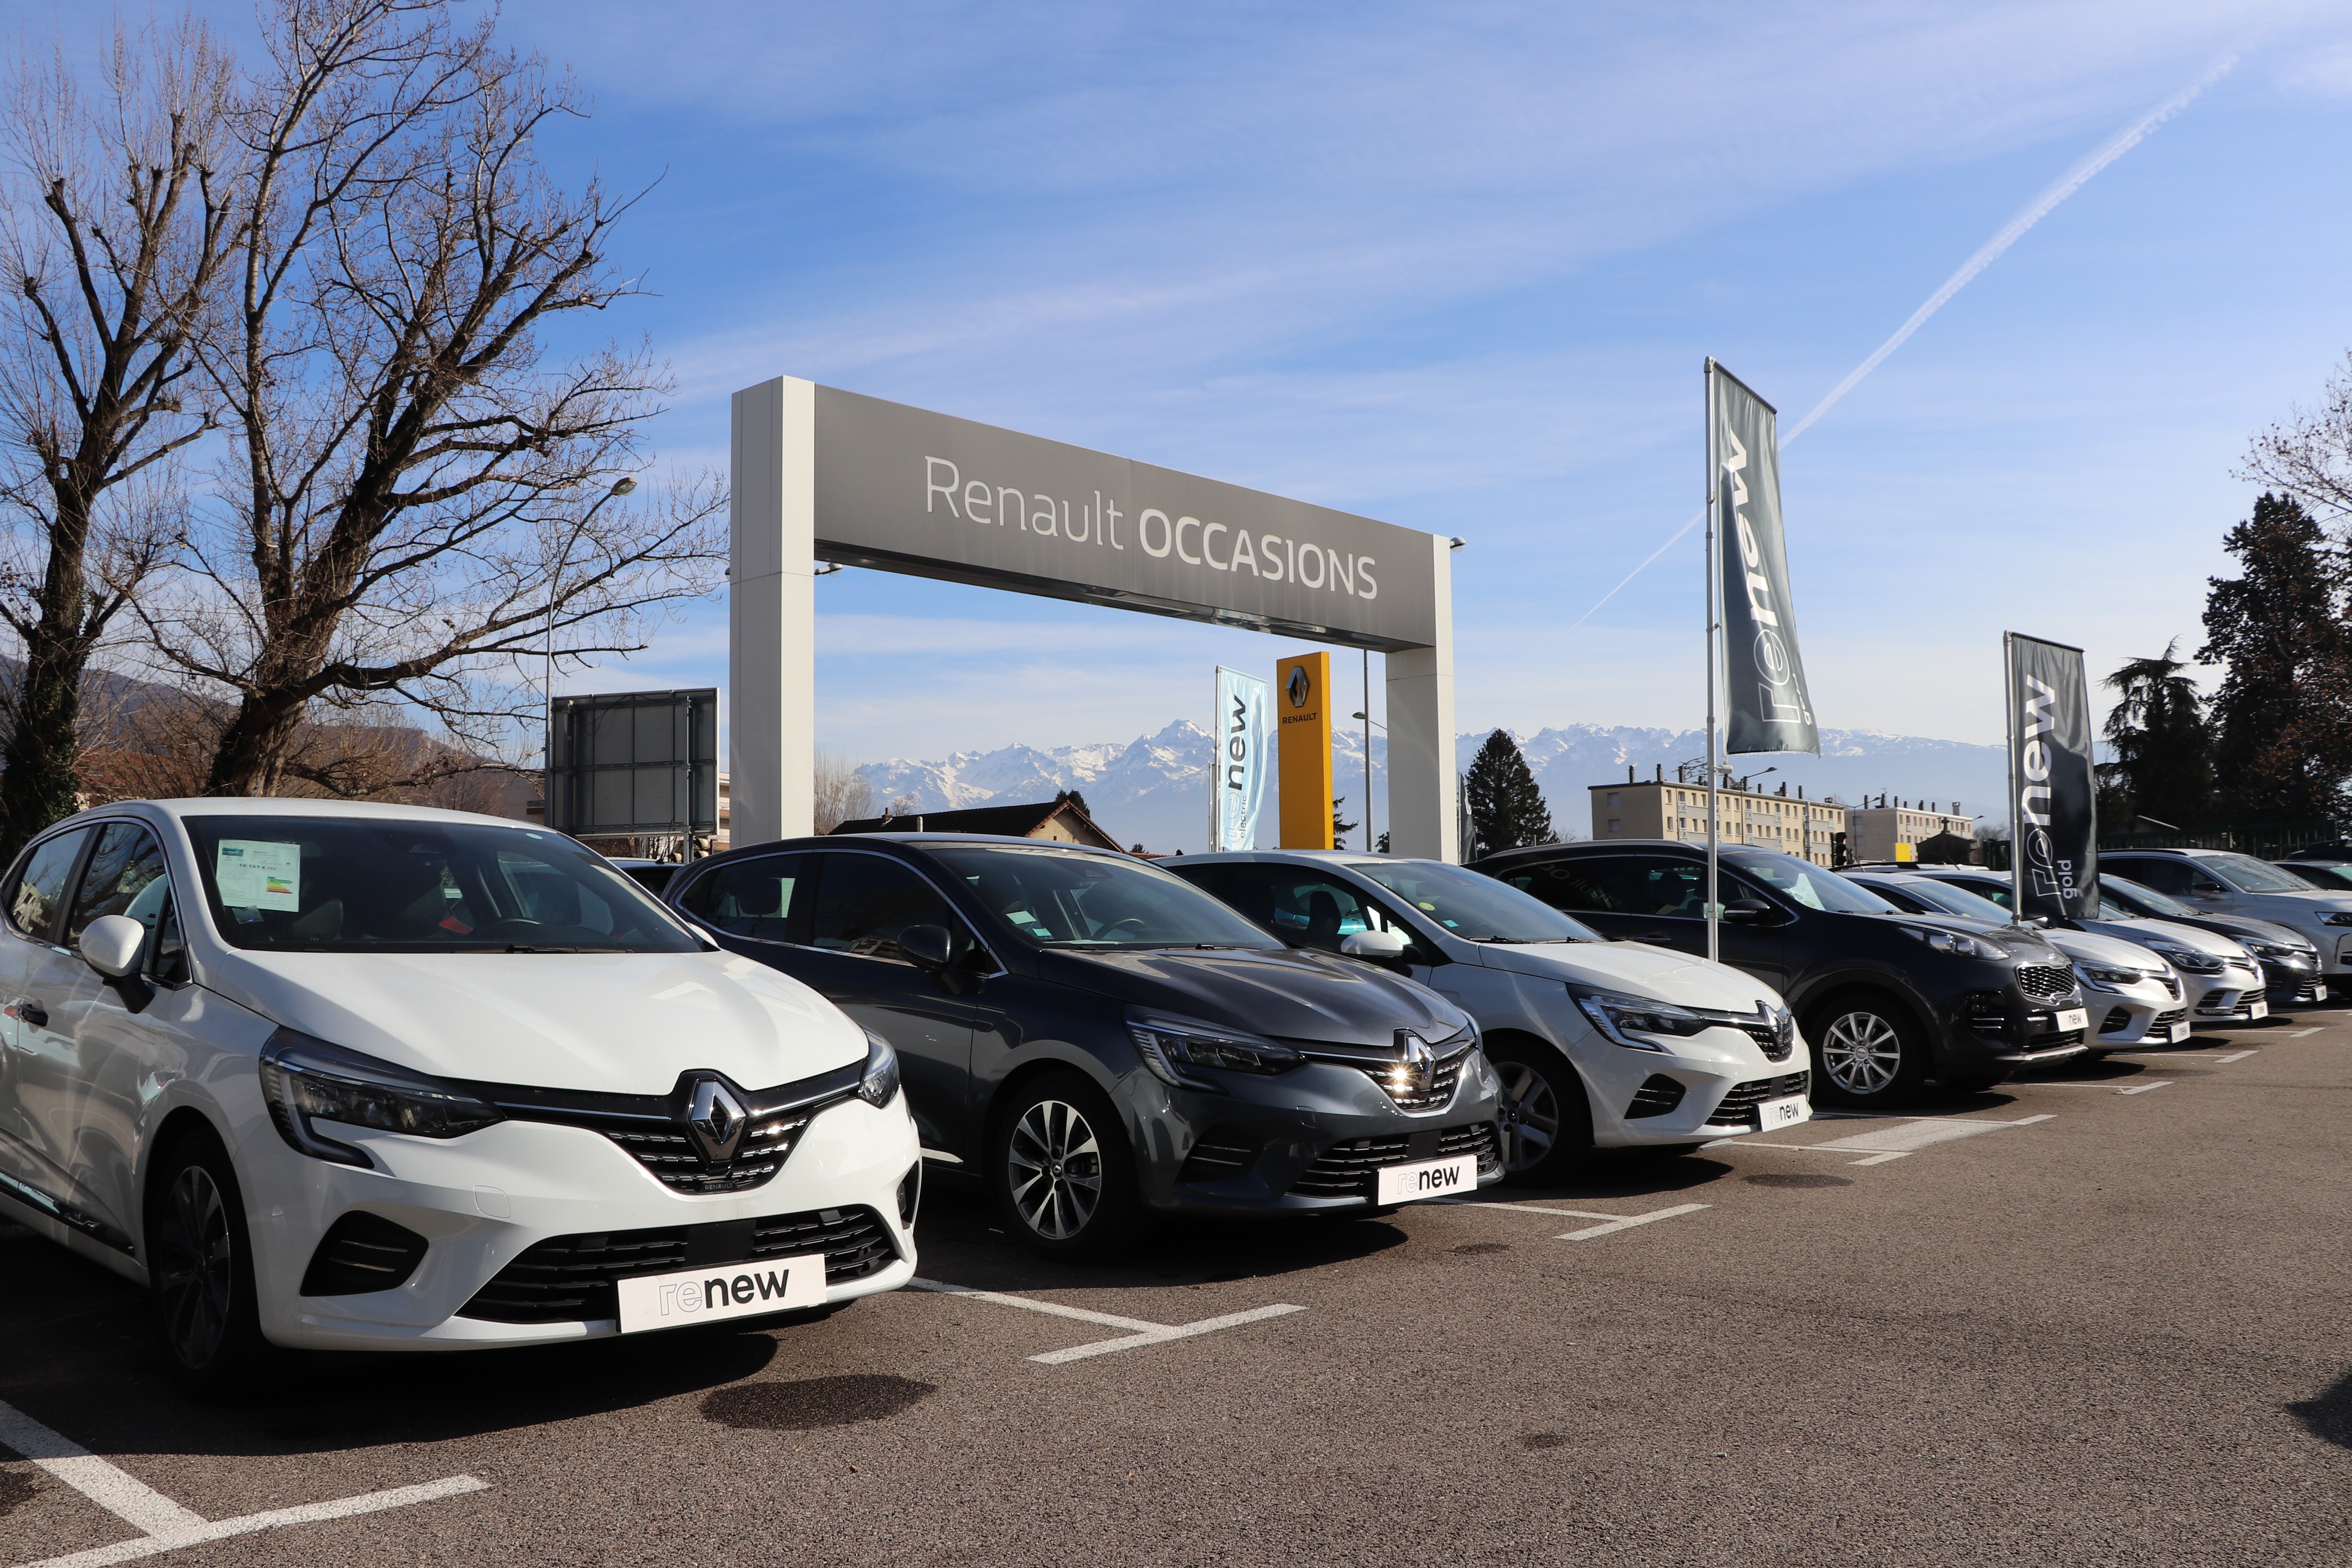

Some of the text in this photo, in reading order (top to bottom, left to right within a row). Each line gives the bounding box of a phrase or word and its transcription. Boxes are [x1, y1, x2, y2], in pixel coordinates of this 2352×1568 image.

[924, 455, 1378, 600] Renault OCCASIONS
[1729, 422, 1801, 723] renew
[1282, 712, 1318, 725] RENAULT
[1226, 694, 1247, 838] renew
[2022, 674, 2061, 897] renew
[1239, 795, 1247, 838] electric
[2057, 859, 2078, 900] gold
[1769, 1102, 1799, 1124] renew
[1397, 1165, 1460, 1194] renew
[659, 1269, 790, 1316] renew
